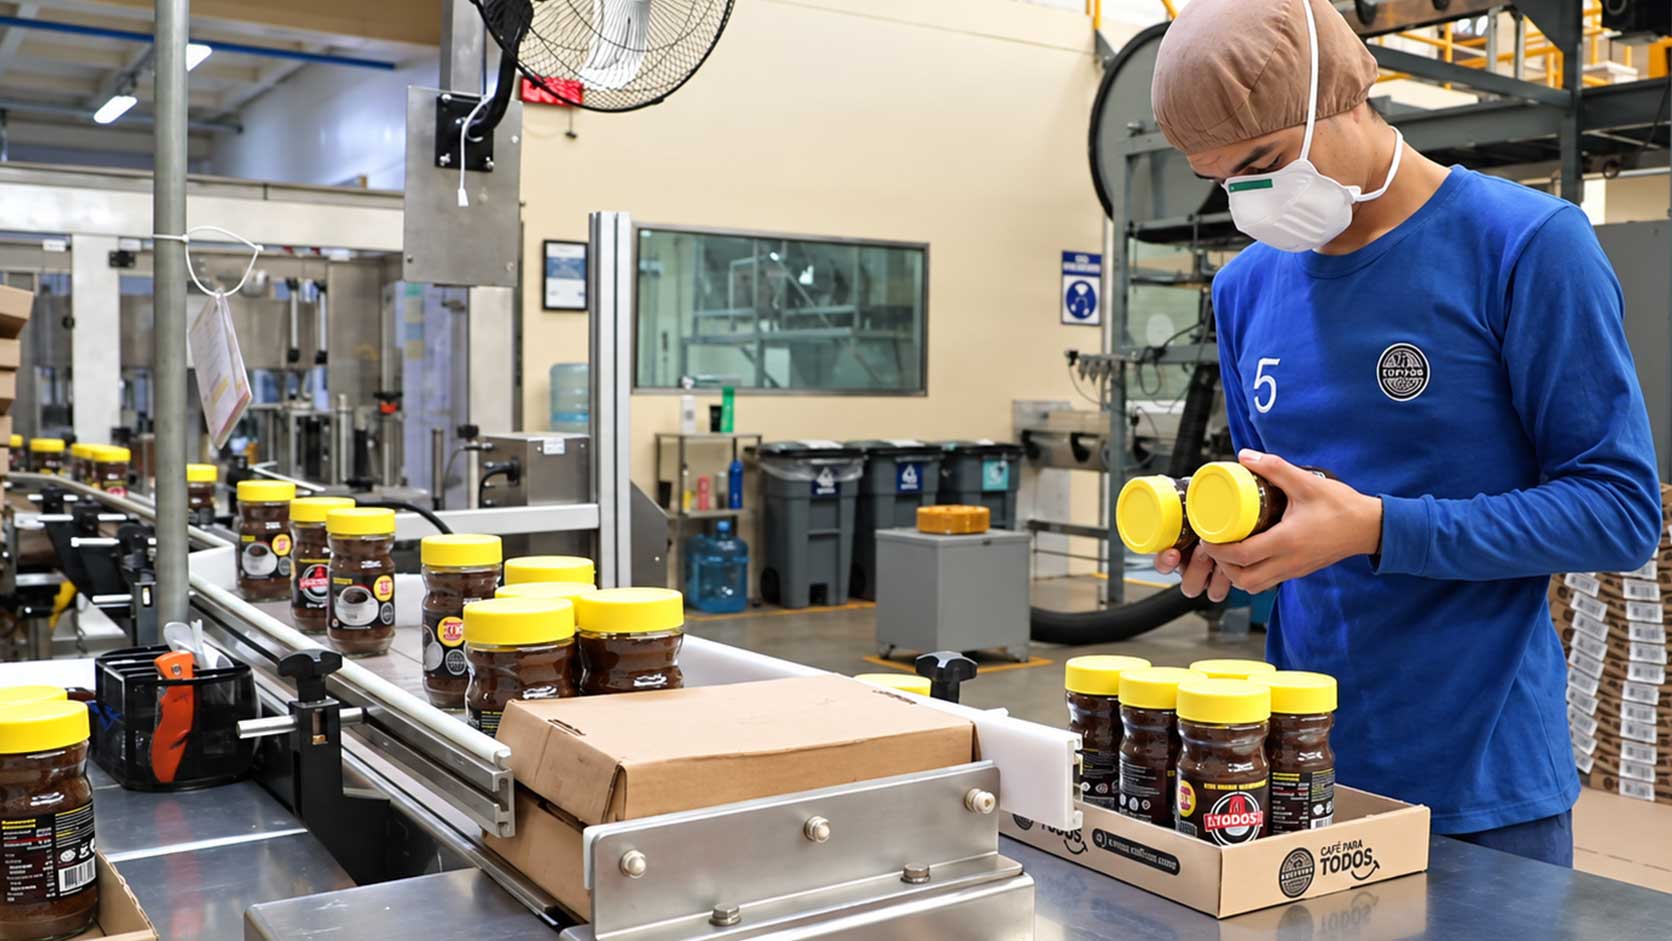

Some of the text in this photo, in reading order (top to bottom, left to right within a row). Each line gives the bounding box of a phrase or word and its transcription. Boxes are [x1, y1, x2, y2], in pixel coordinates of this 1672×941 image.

[1253, 357, 1280, 413] 5
[1320, 839, 1363, 856] CAFÉ PARA
[1320, 847, 1373, 876] TODOS
